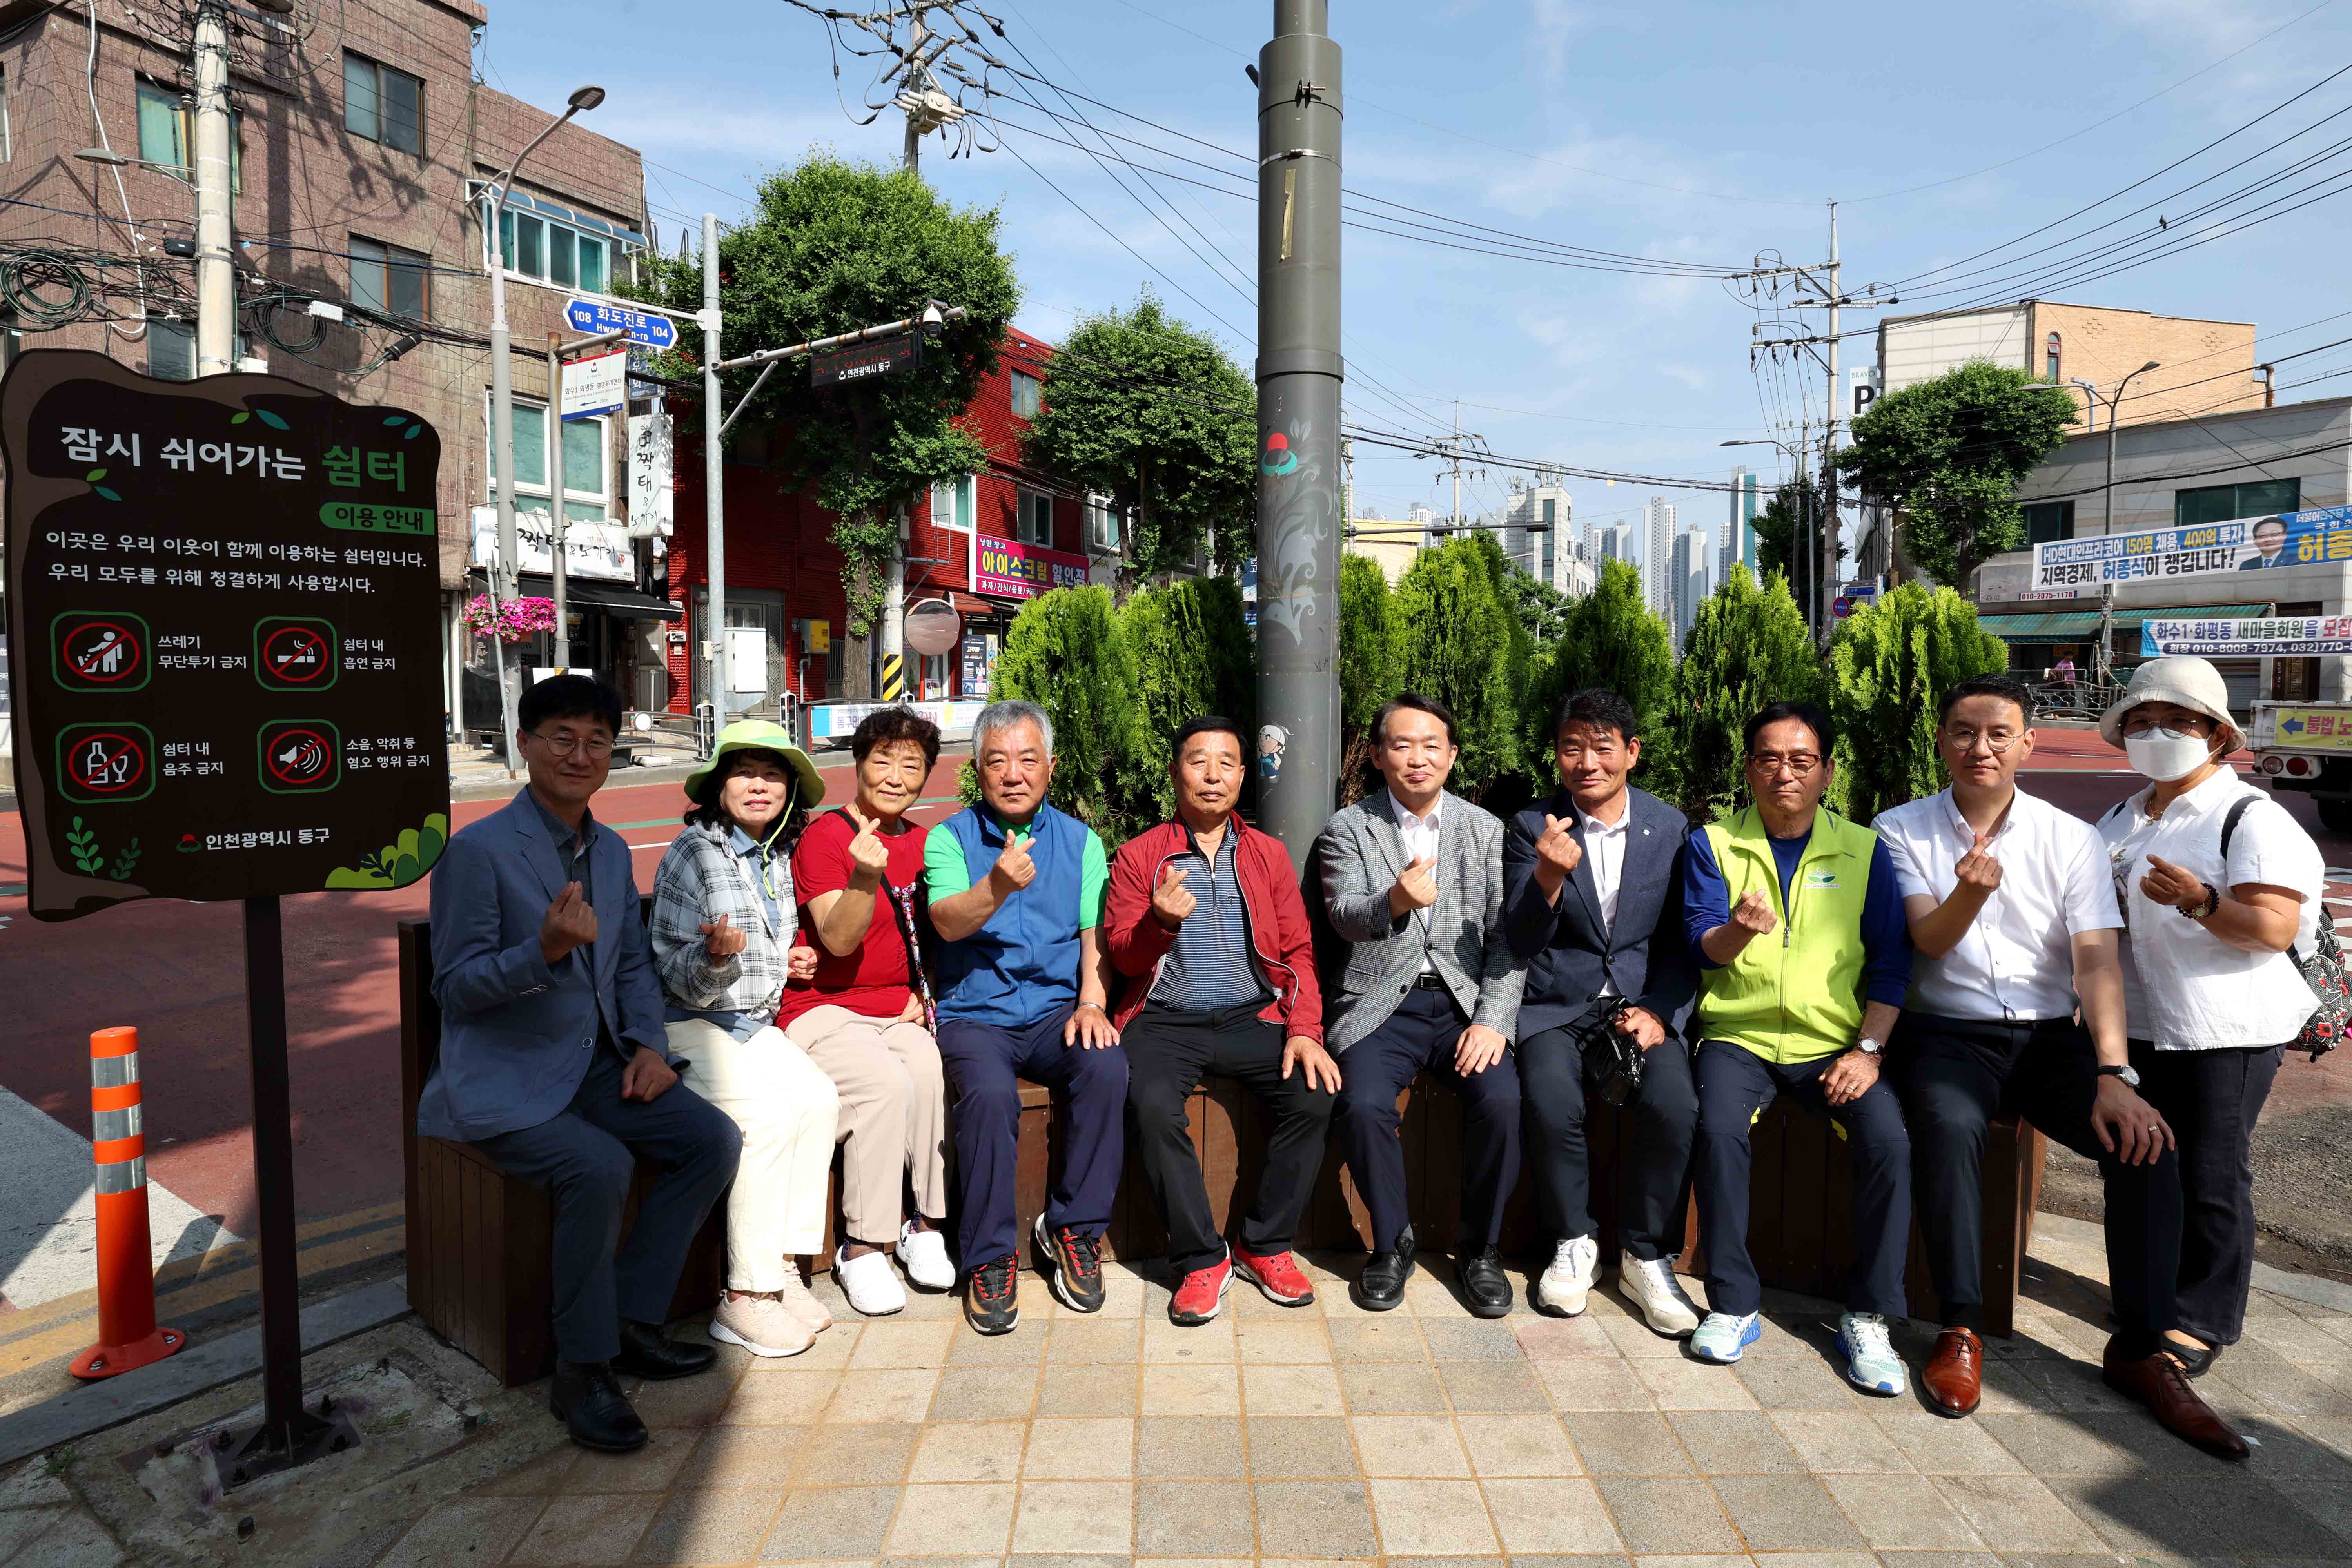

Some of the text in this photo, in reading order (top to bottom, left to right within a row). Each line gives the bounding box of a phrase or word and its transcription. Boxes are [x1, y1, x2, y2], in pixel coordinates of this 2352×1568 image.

[573, 310, 592, 323] 108
[597, 307, 648, 328] 화도진로
[597, 323, 648, 341] Hwadin-ro
[652, 326, 669, 338] 104
[848, 361, 891, 378] 인천광역시 동구
[1851, 370, 1875, 379] BRAVO
[61, 427, 405, 492] 잠시 쉬어가는 쉼터
[636, 452, 655, 492] 짝태
[334, 506, 423, 532] 이용 안내
[631, 510, 658, 526] 노가리
[2296, 508, 2345, 523] 더불어민주당
[46, 531, 426, 567] 이곳은 우리 이웃이 함께 이용하는 쉼터입니다.
[980, 538, 1006, 549] 낭만 창고
[2043, 525, 2243, 564] HD현대인프라코어 150명 채용, 400억 투자
[579, 544, 615, 564] 노가리
[982, 550, 1085, 586] 아이스크림 할인점
[2041, 548, 2236, 586] 지역경제, 허종식이 챙깁니다!
[48, 563, 375, 593] 우리 모두를 위해 청결하게 사용합시다.
[2022, 591, 2073, 600] 010-2075-1178
[2236, 619, 2318, 640] 새마을회원을
[2323, 618, 2352, 637] 모집
[158, 635, 200, 649] 쓰레기
[343, 639, 383, 652] 쉼터 내
[2169, 643, 2190, 653] 회장
[2192, 642, 2287, 653] 010-8009-7974,
[159, 655, 246, 669] 무단투기 금지
[344, 657, 395, 670] 흡연 금지
[2306, 715, 2336, 735] 불법
[163, 742, 209, 756] 쉼터 내
[346, 737, 416, 751] 소음, 악취 등
[163, 761, 223, 776] 음주 금지
[347, 754, 429, 769] 혐오 행위 금지
[206, 828, 330, 850] 인천광역시 동구
